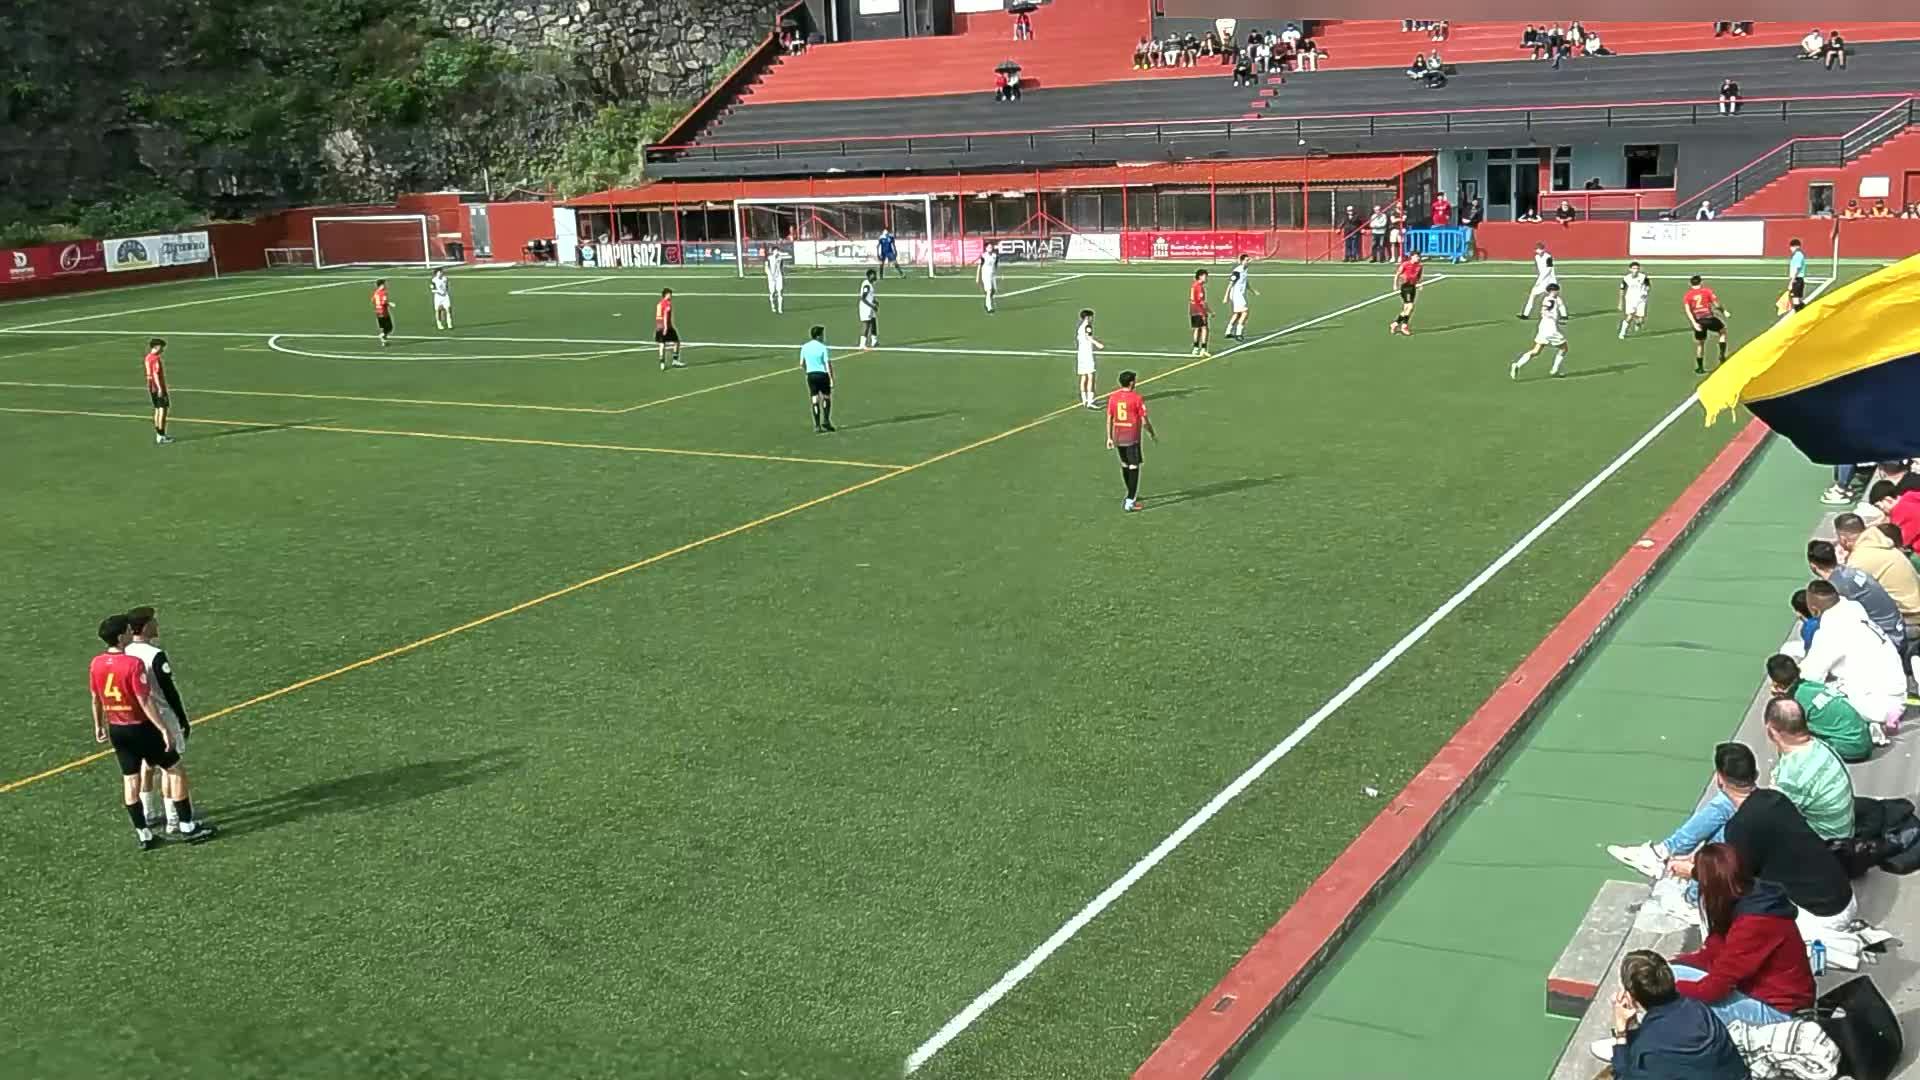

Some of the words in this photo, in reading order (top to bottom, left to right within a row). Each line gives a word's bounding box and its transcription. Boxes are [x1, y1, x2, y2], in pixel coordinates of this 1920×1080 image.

[596, 243, 661, 268] IMPULSO27
[1117, 401, 1128, 421] 6
[103, 673, 122, 702] 4
